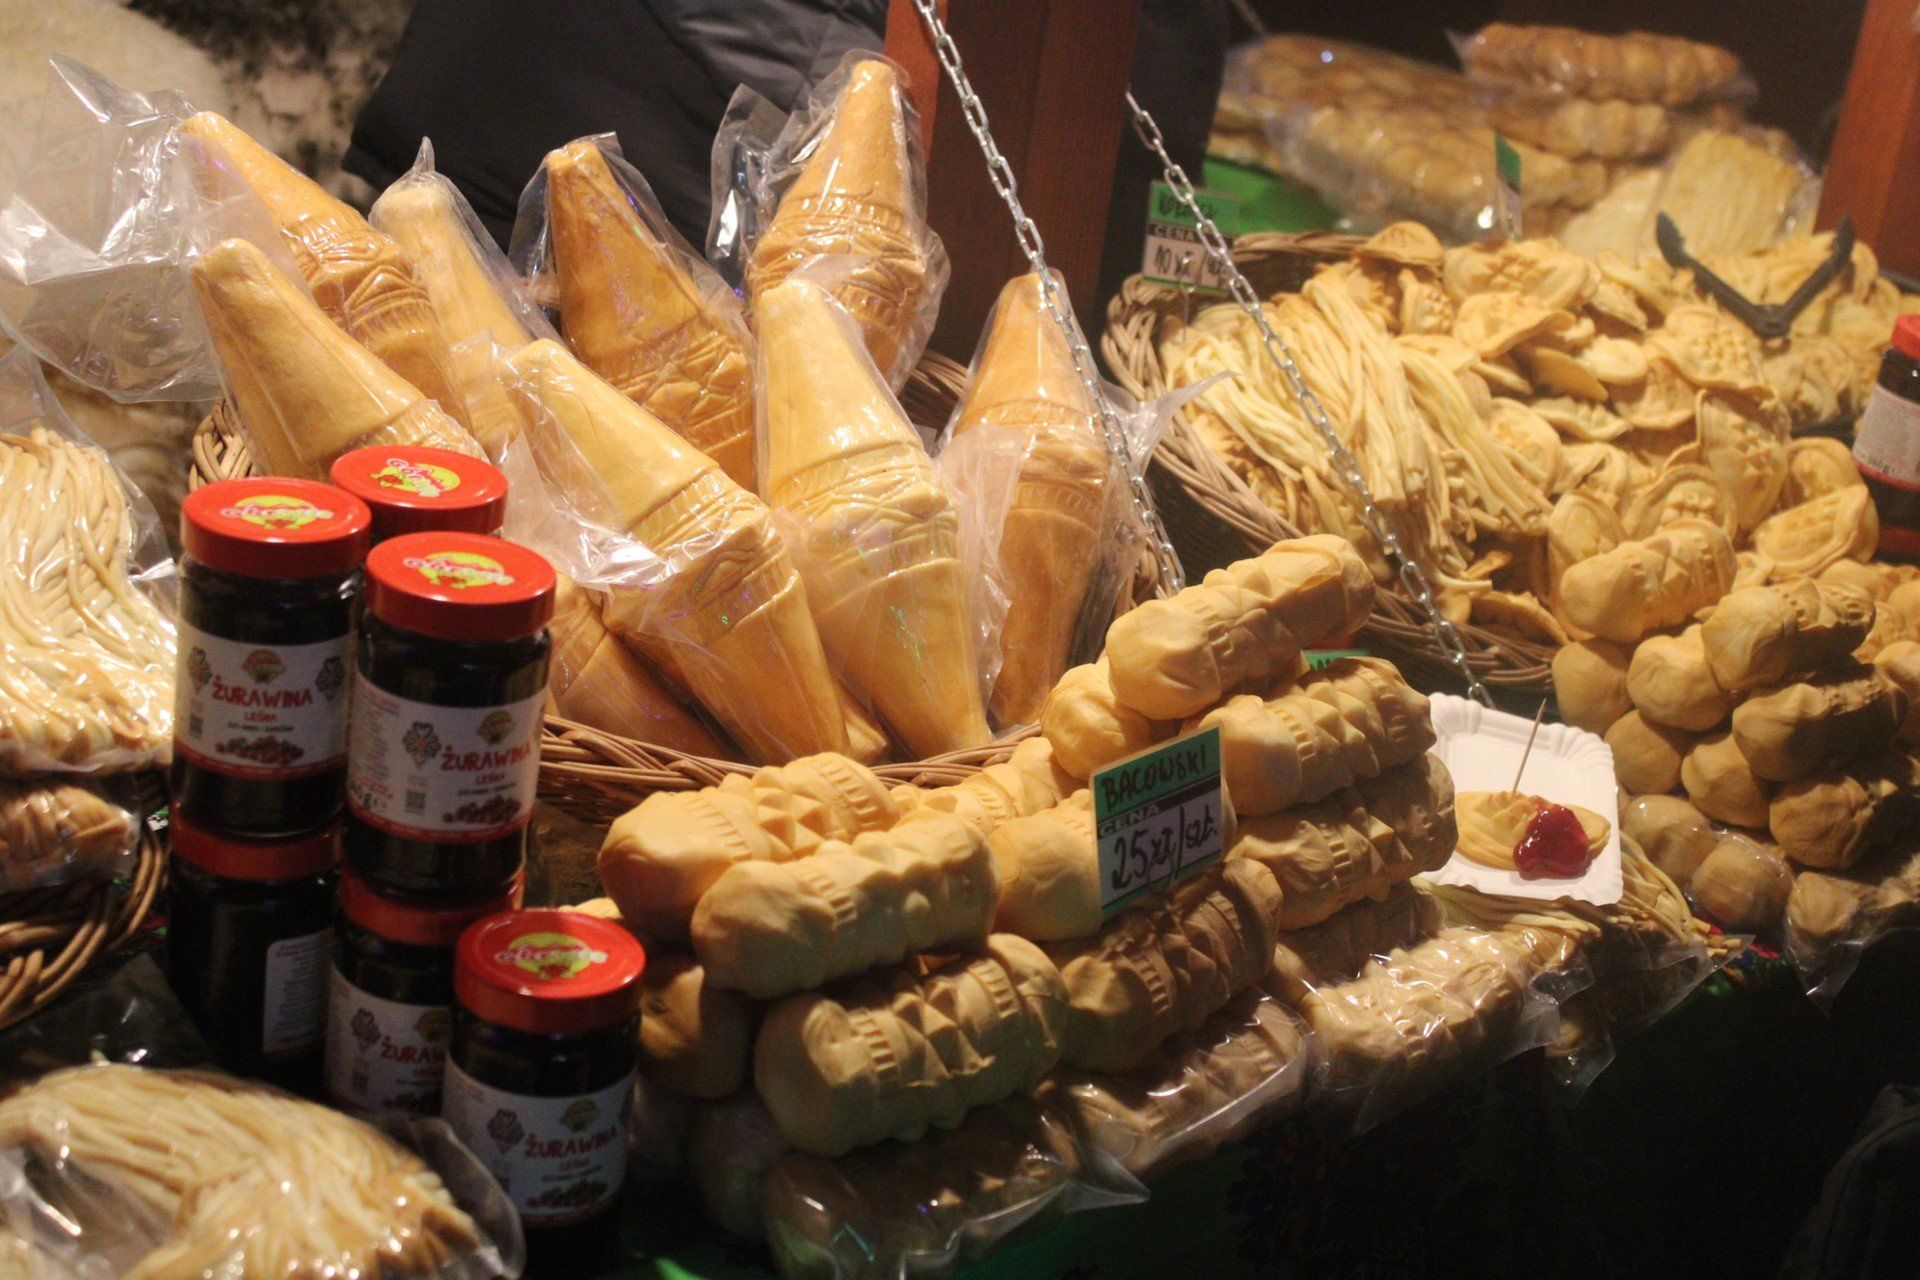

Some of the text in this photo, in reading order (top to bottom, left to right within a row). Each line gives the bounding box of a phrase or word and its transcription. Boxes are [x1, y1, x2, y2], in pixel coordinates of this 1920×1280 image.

[212, 674, 313, 707] ŻURAWINA
[441, 739, 532, 771] ŻURAWINA
[1099, 803, 1159, 838] CENA
